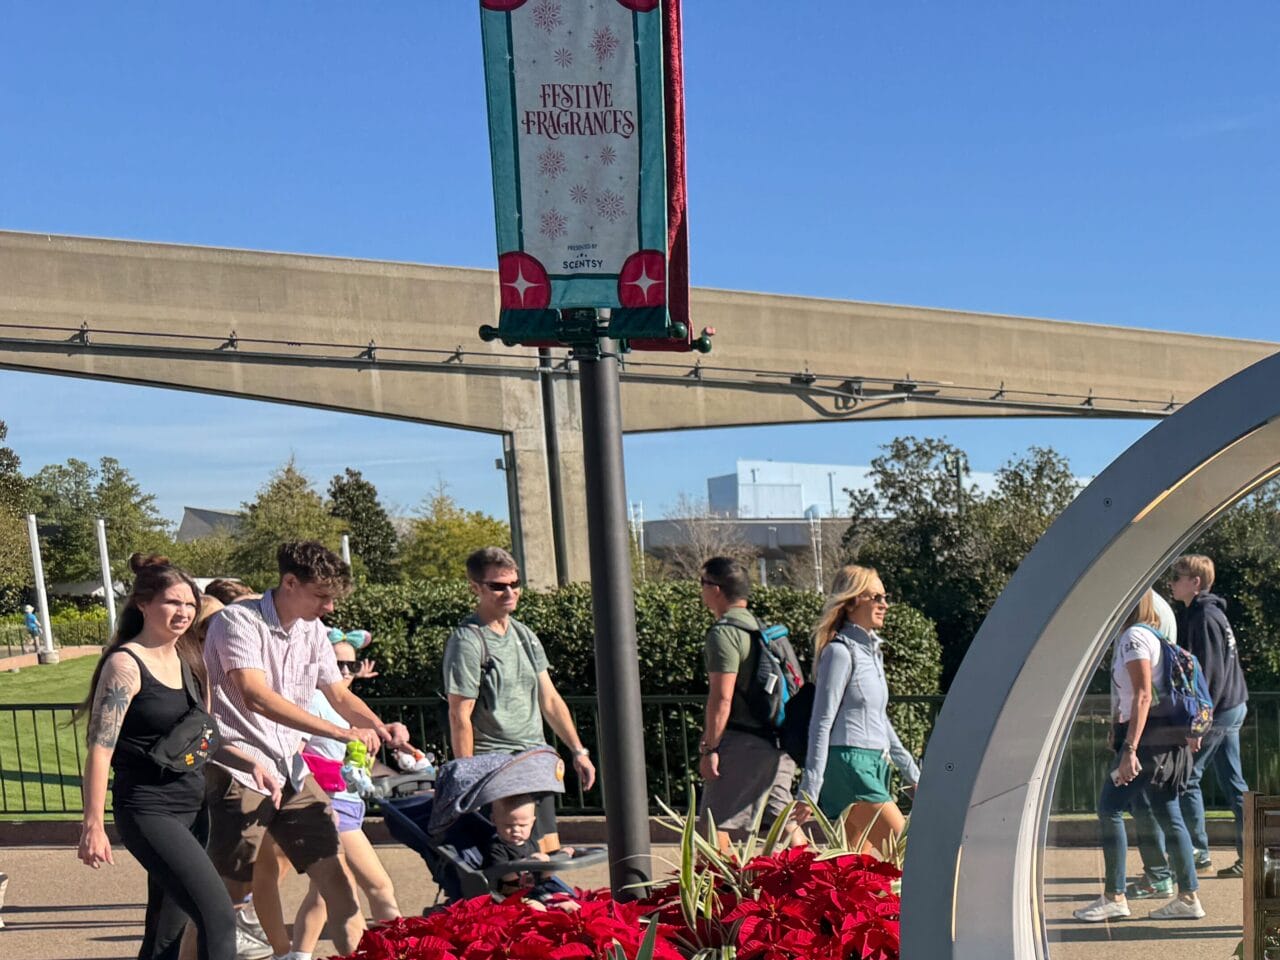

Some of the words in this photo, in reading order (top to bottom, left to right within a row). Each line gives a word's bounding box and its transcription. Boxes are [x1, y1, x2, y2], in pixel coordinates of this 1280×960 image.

[539, 81, 613, 112] FESTIVE
[521, 109, 635, 140] FRAGRANCES
[562, 260, 603, 269] SCENTSY
